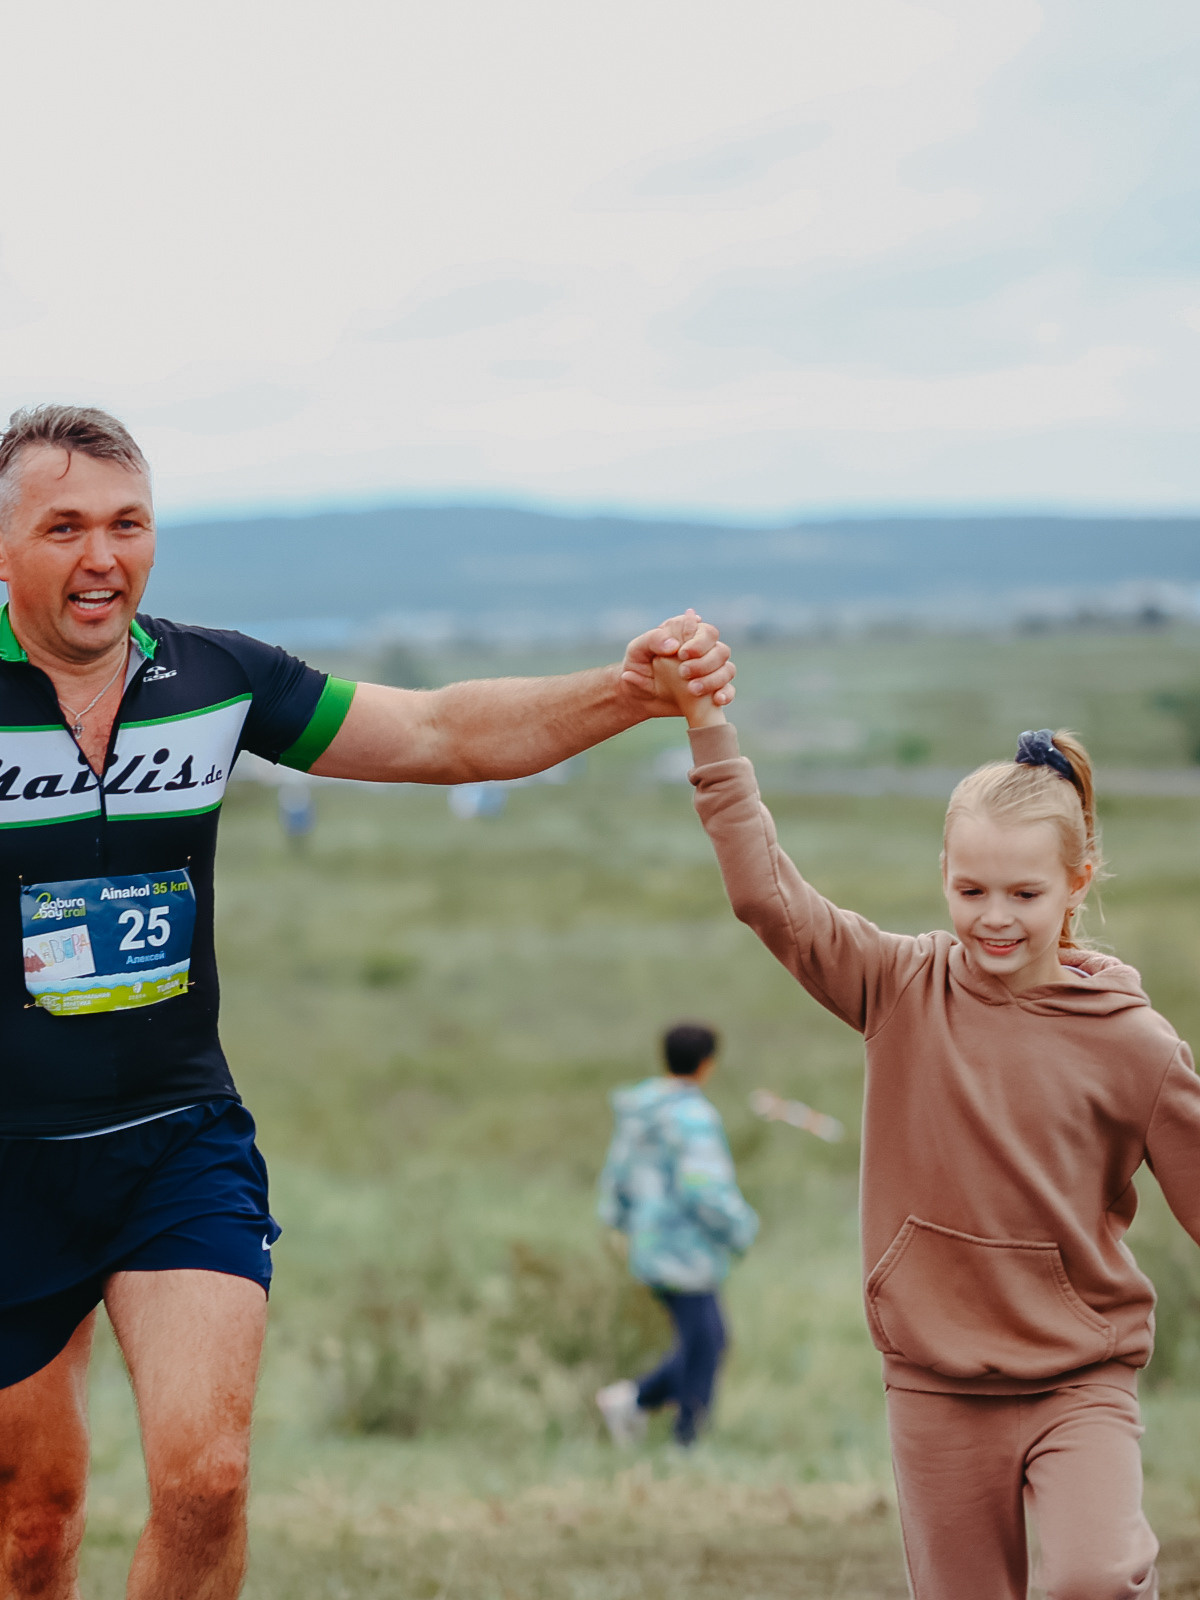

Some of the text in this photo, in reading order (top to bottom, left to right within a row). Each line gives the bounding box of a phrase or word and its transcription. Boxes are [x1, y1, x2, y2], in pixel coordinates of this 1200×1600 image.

[100, 881, 189, 900] Ainakol 35 km
[63, 906, 87, 918] trail
[118, 905, 171, 951] 25
[125, 950, 165, 965] Алексей
